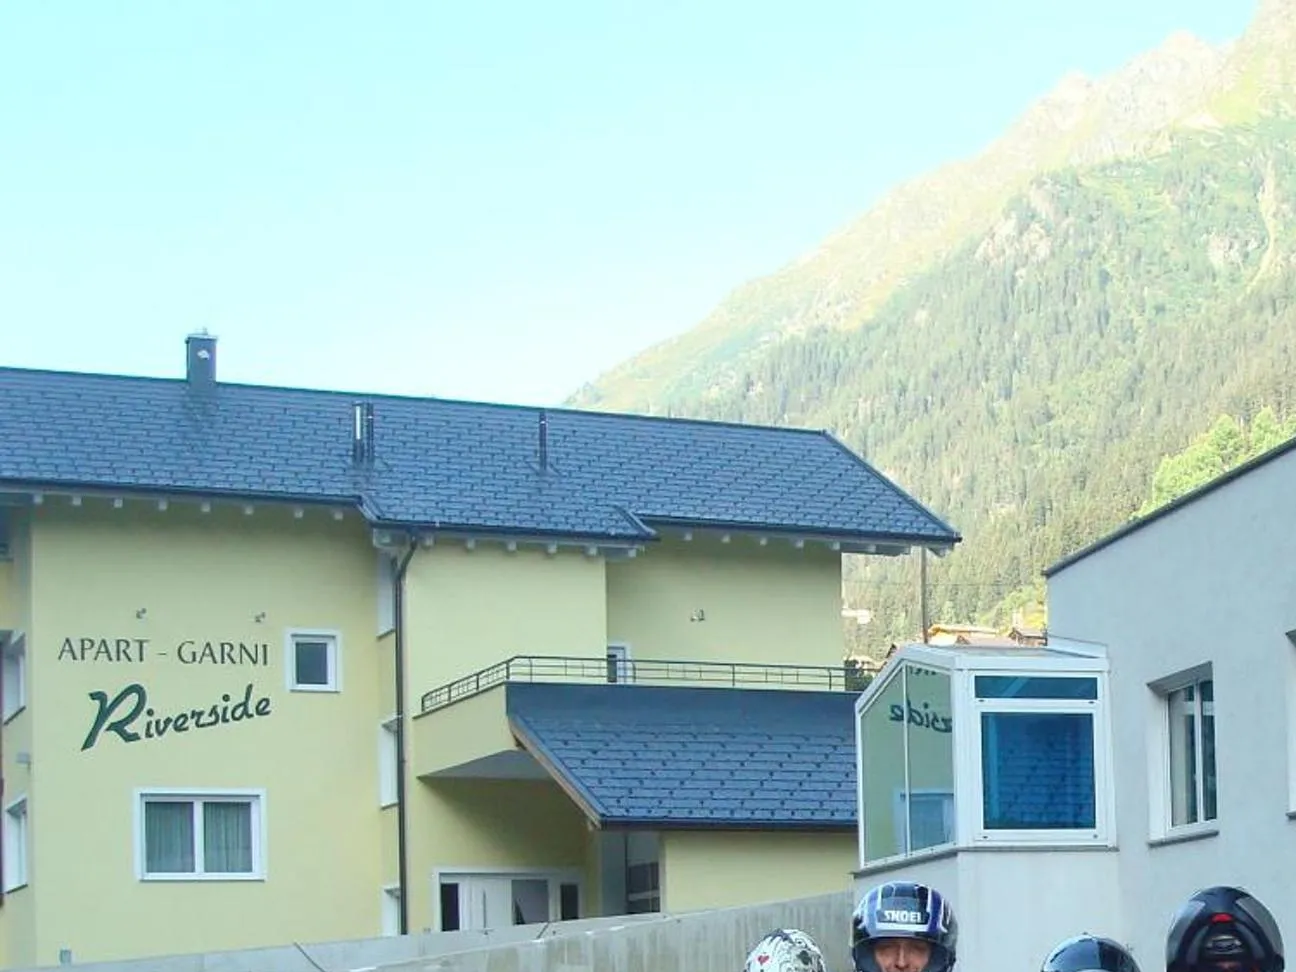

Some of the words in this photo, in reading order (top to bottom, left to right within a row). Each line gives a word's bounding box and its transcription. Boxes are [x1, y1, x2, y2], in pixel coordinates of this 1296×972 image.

[58, 637, 150, 663] APART
[177, 640, 269, 667] GARNI
[80, 683, 271, 752] Riverside
[883, 909, 922, 923] SHOEI
